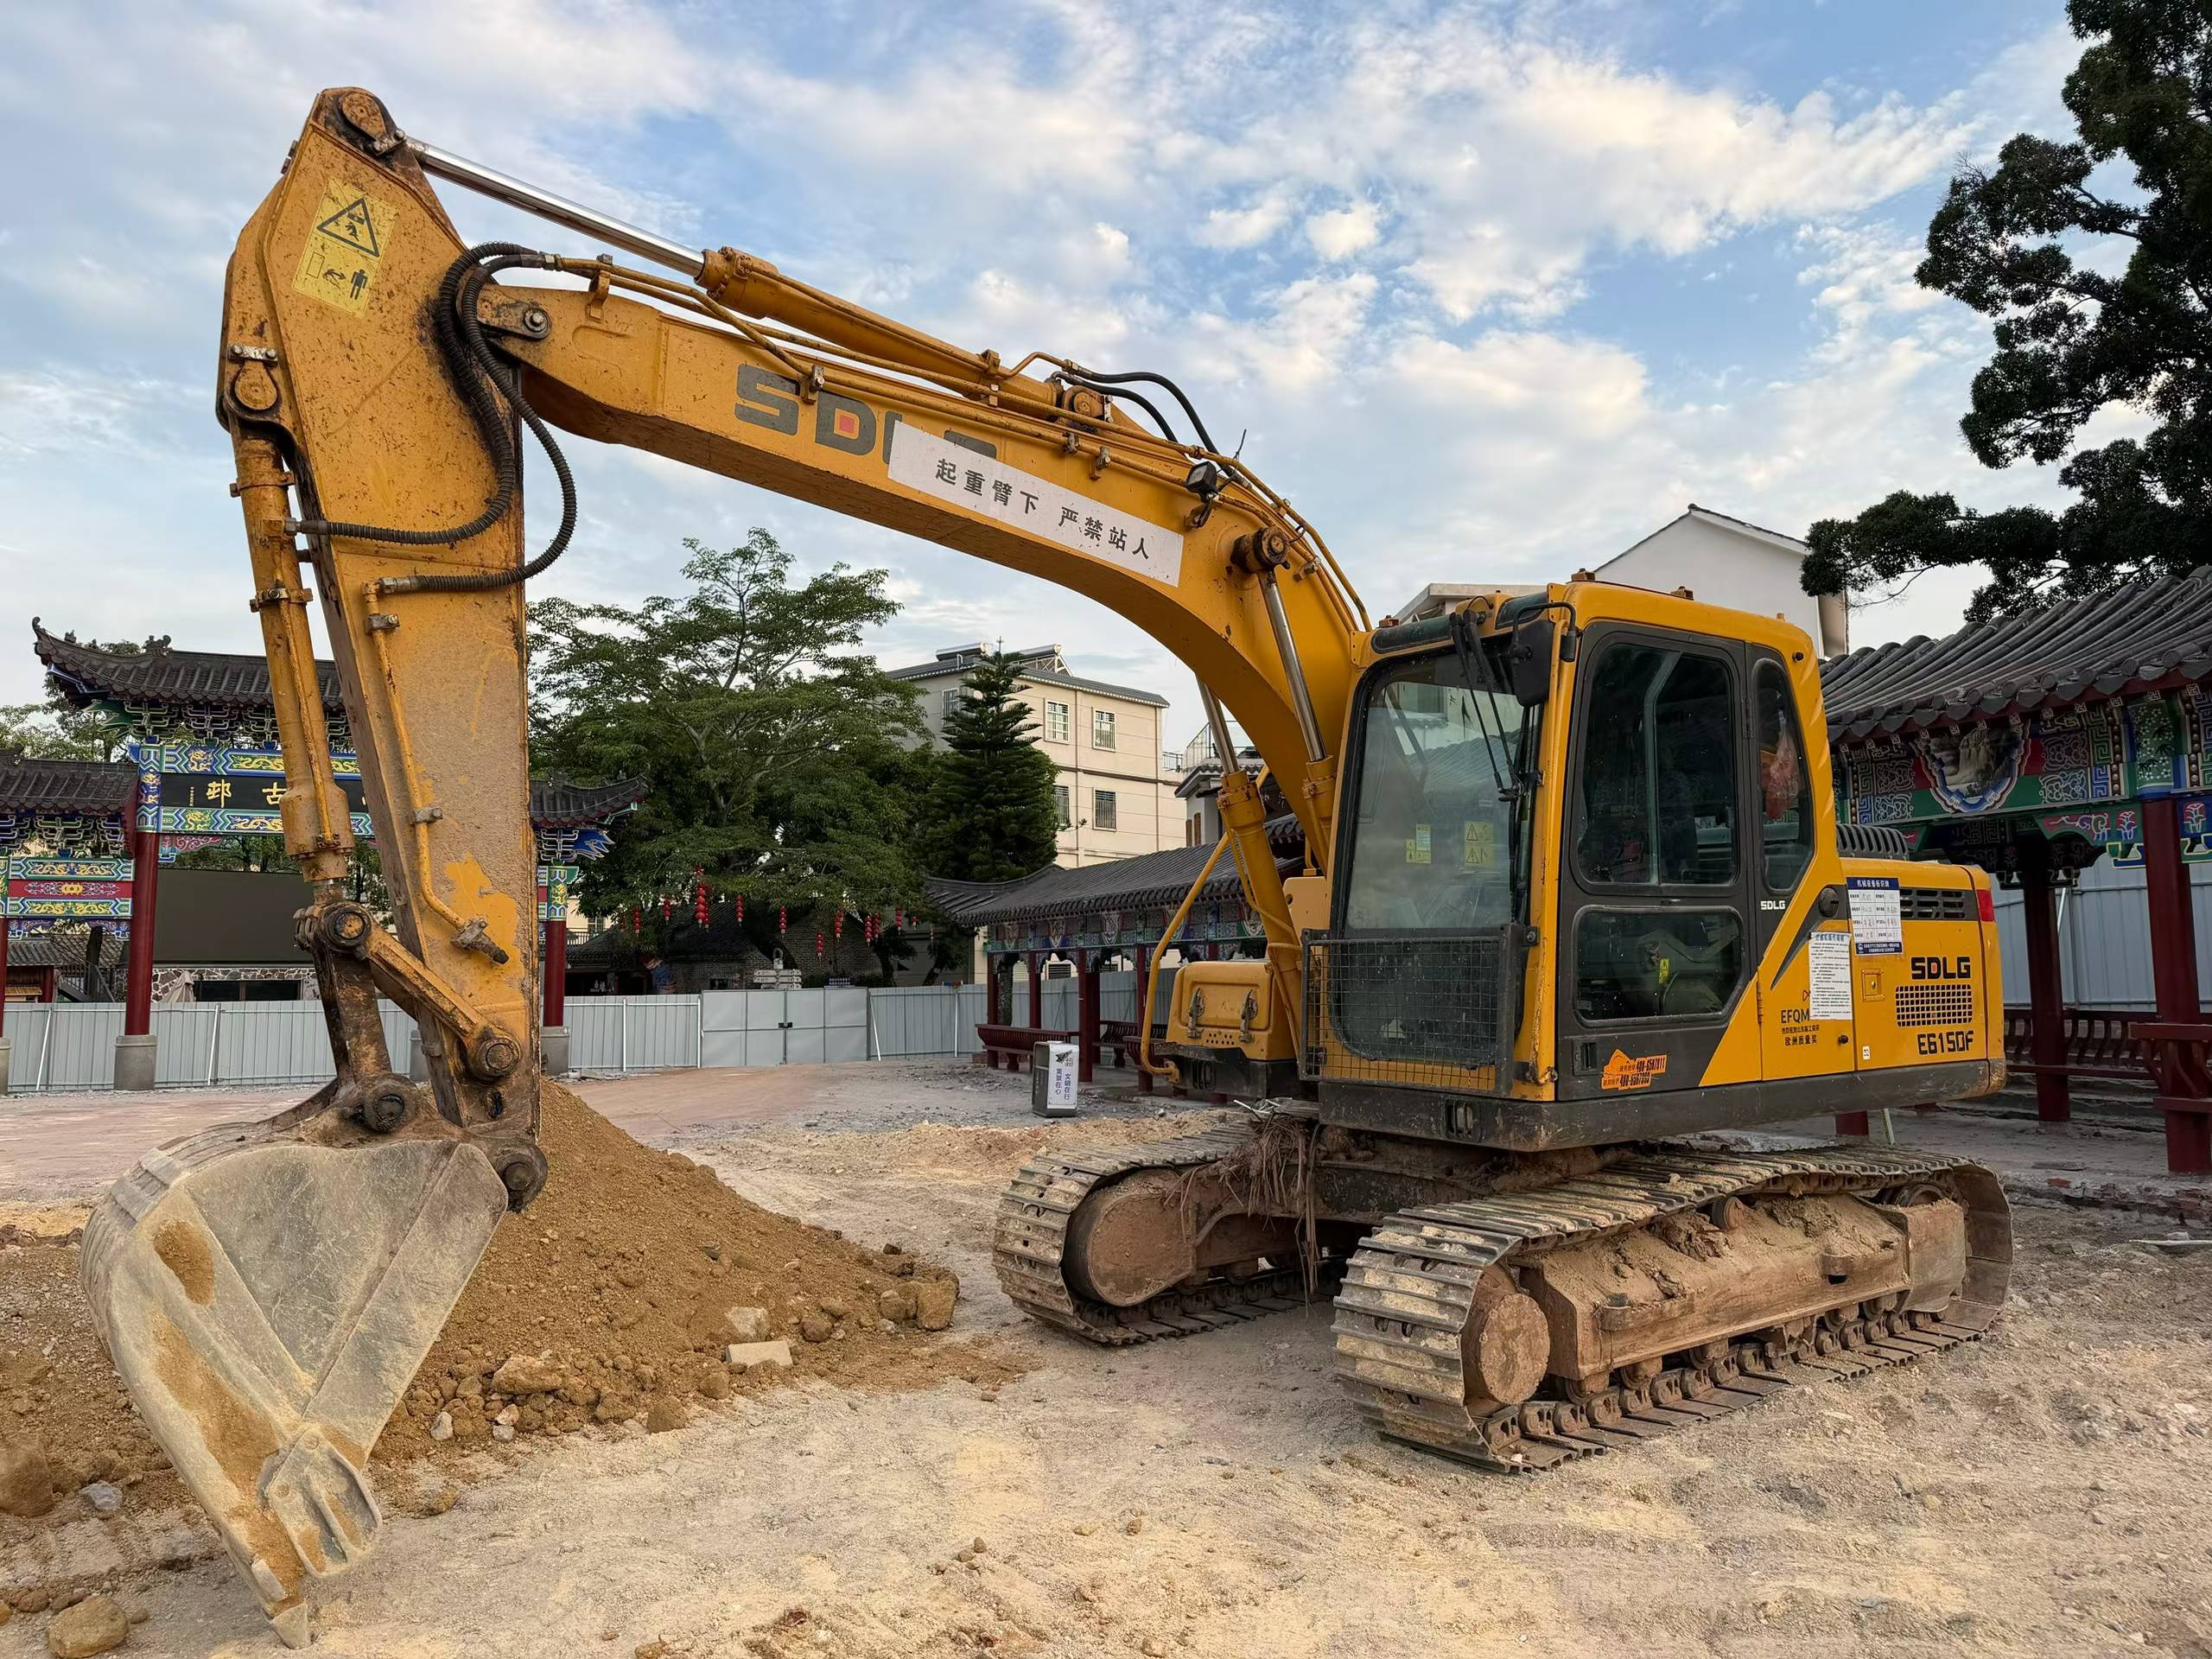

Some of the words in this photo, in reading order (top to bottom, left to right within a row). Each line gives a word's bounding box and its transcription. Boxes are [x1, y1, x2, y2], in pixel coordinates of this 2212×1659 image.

[734, 363, 997, 464] SD
[936, 457, 1039, 515] 起重臂下
[1058, 505, 1150, 560] 严禁站人
[1760, 899, 1786, 910] SDLG
[1911, 957, 1971, 979] SDLG
[1781, 1008, 1810, 1023] EFQM
[1917, 1030, 1974, 1055] E6150F
